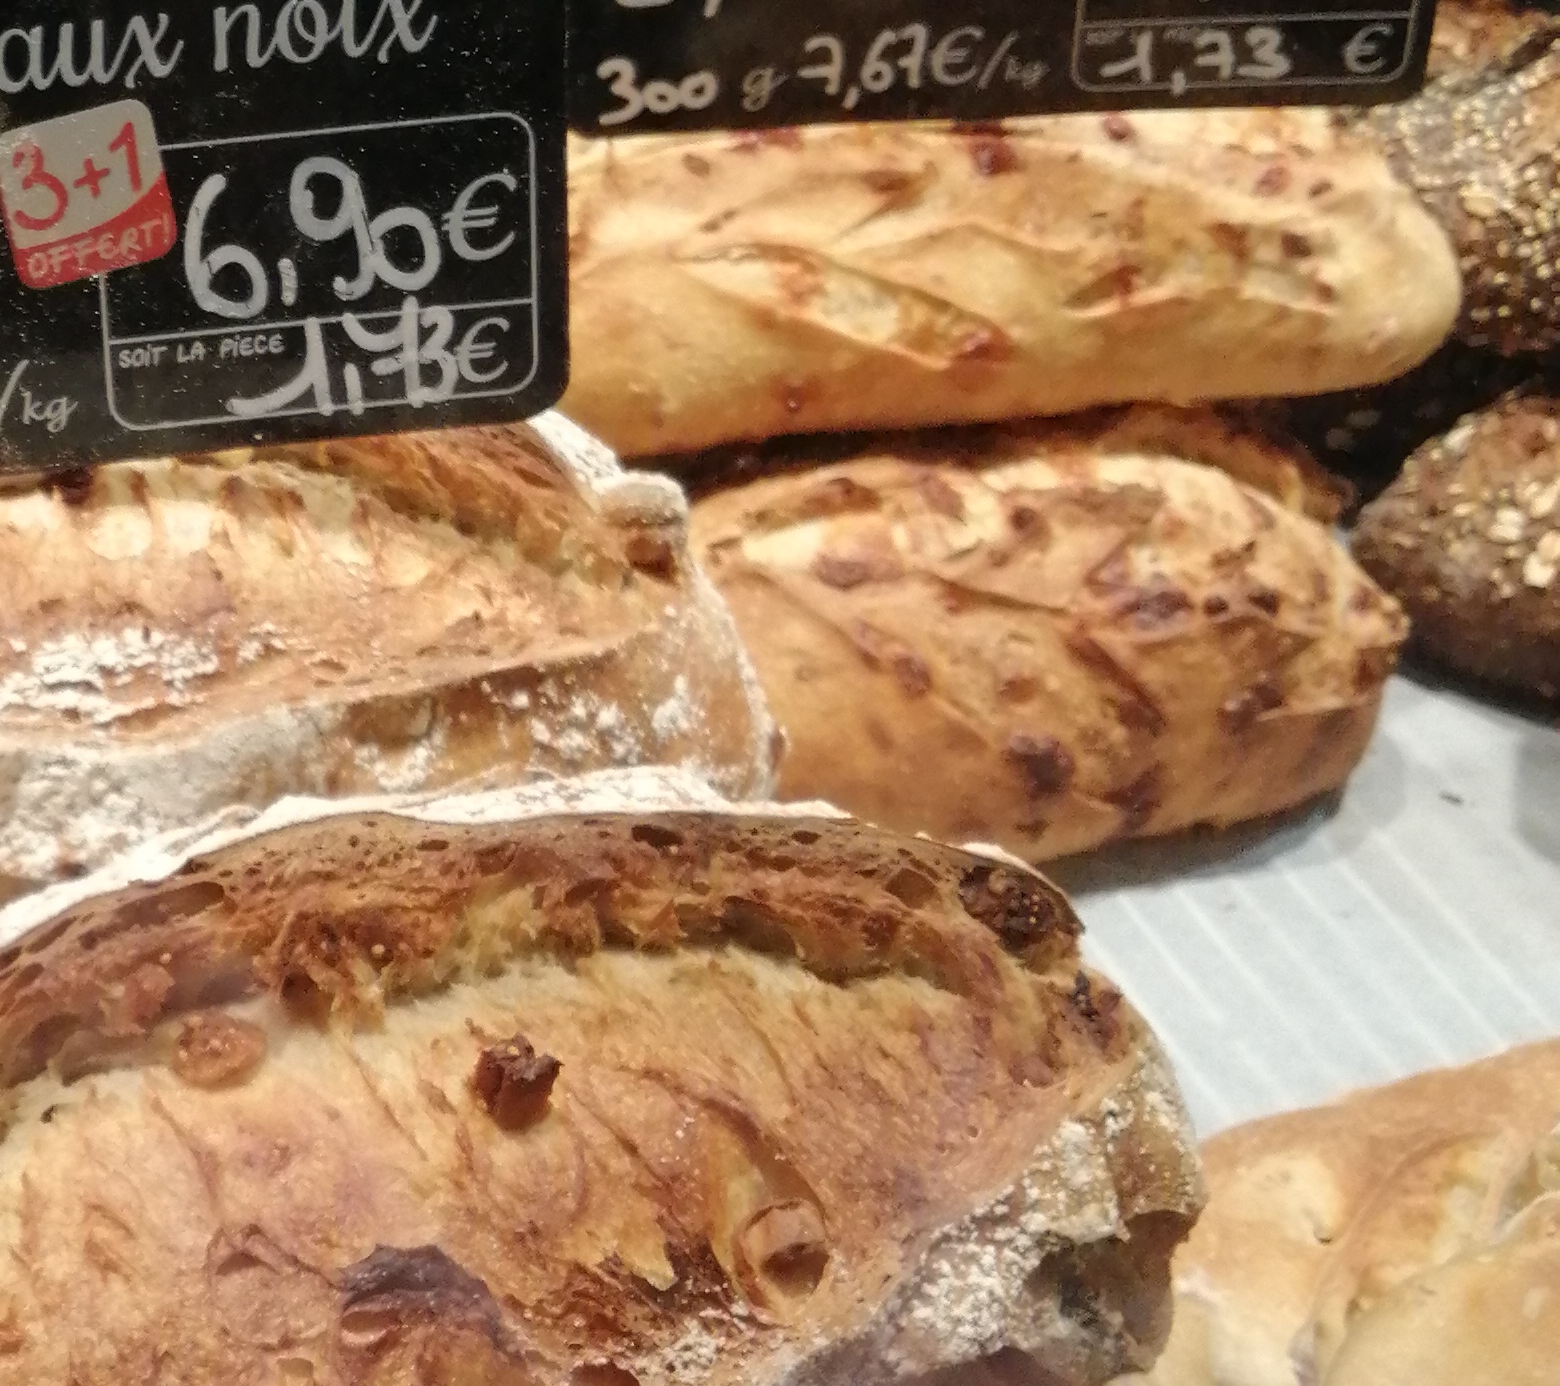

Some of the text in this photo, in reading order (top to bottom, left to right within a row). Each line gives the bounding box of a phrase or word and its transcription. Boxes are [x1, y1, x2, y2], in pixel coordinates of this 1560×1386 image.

[595, 54, 720, 128] 300
[12, 119, 143, 232] 3+1
[175, 339, 207, 364] LA
